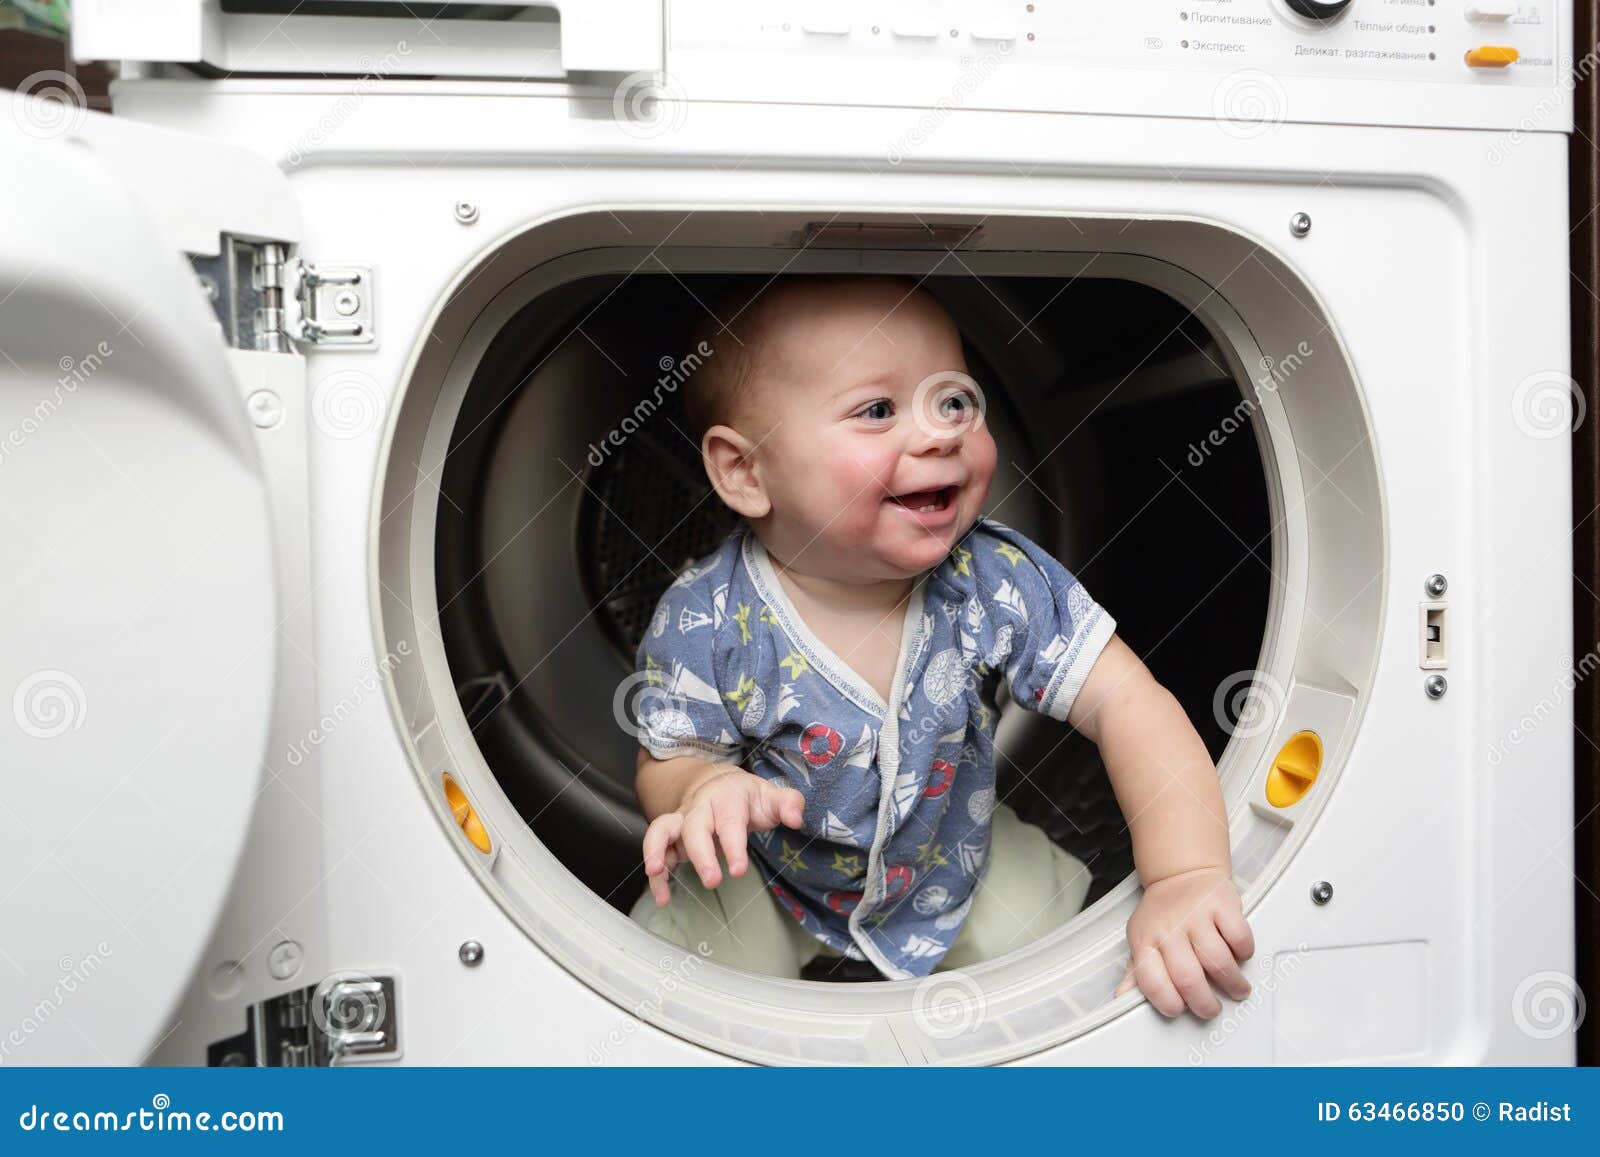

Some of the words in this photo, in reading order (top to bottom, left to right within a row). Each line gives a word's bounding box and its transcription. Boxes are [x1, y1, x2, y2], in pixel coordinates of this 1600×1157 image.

[1191, 11, 1272, 26] Пропитывание
[1395, 21, 1427, 35] обдув
[1192, 39, 1246, 53] Экспресс
[1295, 44, 1341, 58] Деликат.
[1345, 48, 1427, 61] разглаживание
